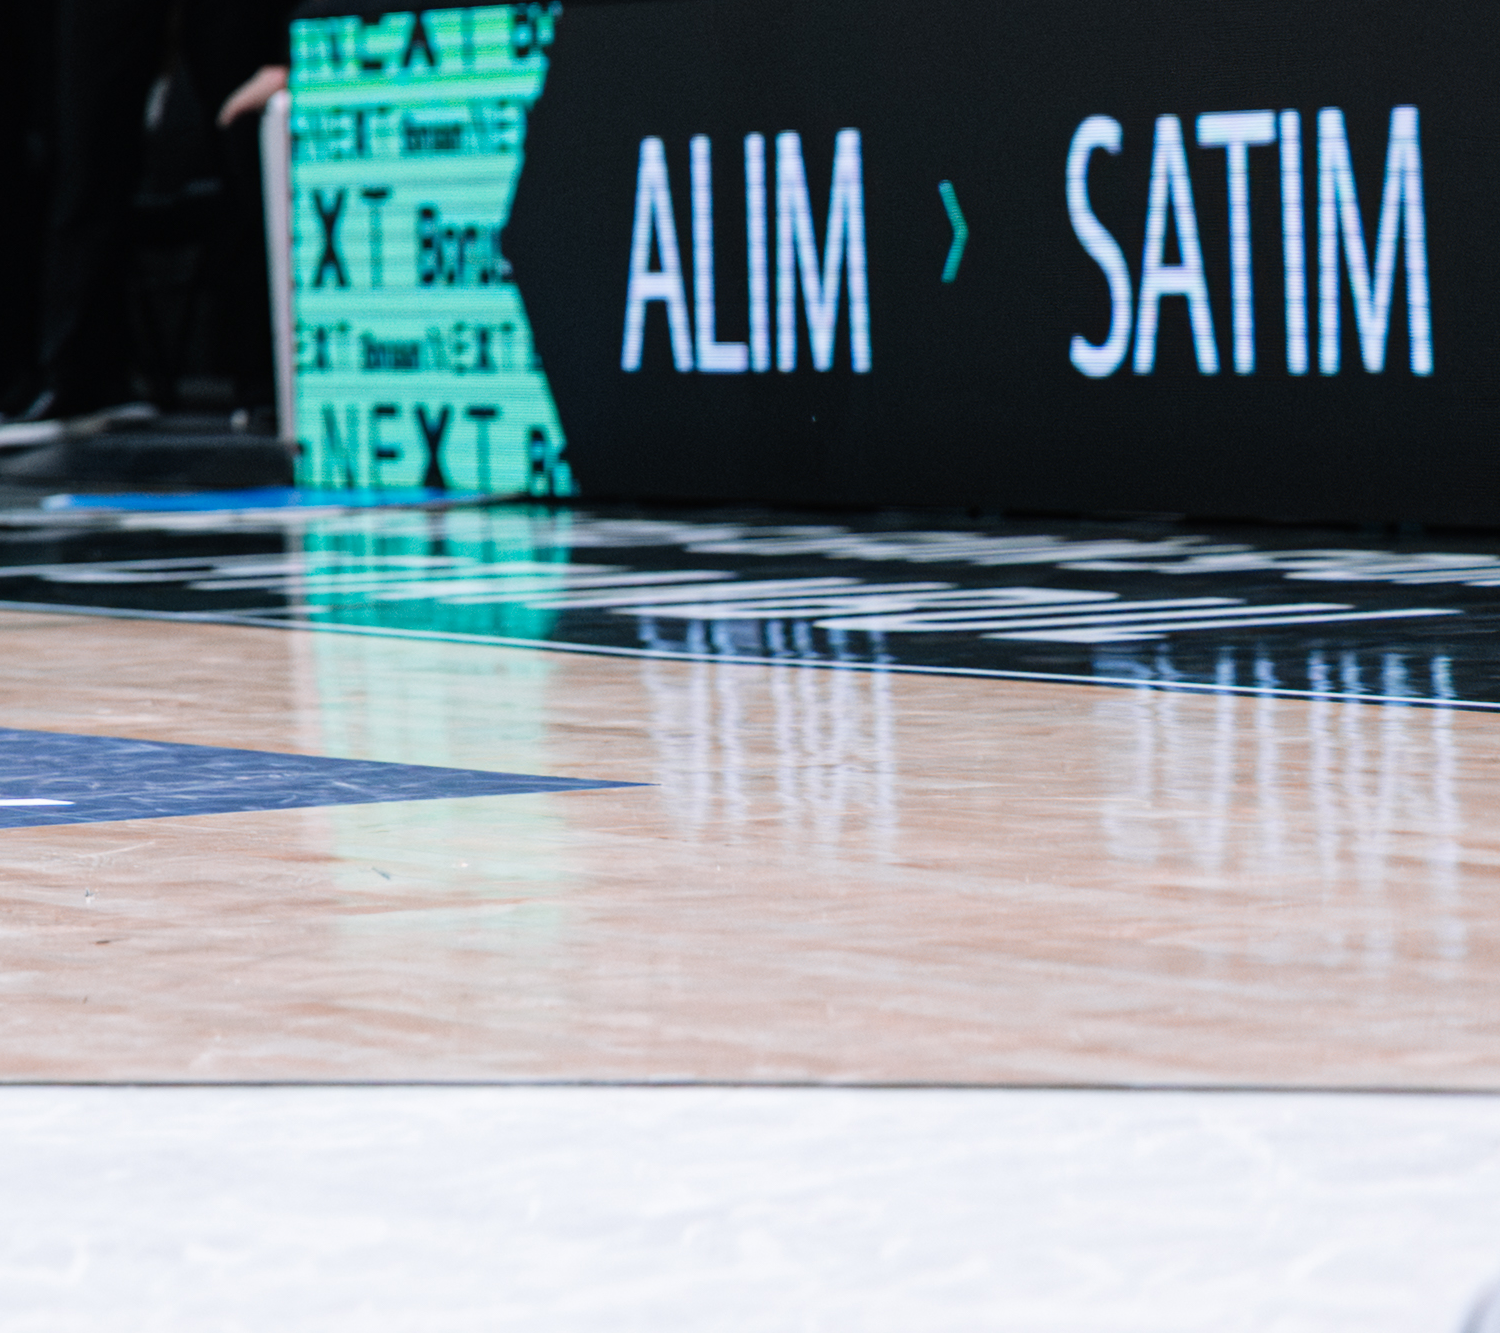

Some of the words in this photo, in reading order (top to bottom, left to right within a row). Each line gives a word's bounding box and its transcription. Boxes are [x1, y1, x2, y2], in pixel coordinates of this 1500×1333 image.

[311, 185, 396, 289] XT
[620, 128, 872, 373] ALIM
[1066, 104, 1436, 377] SATIM
